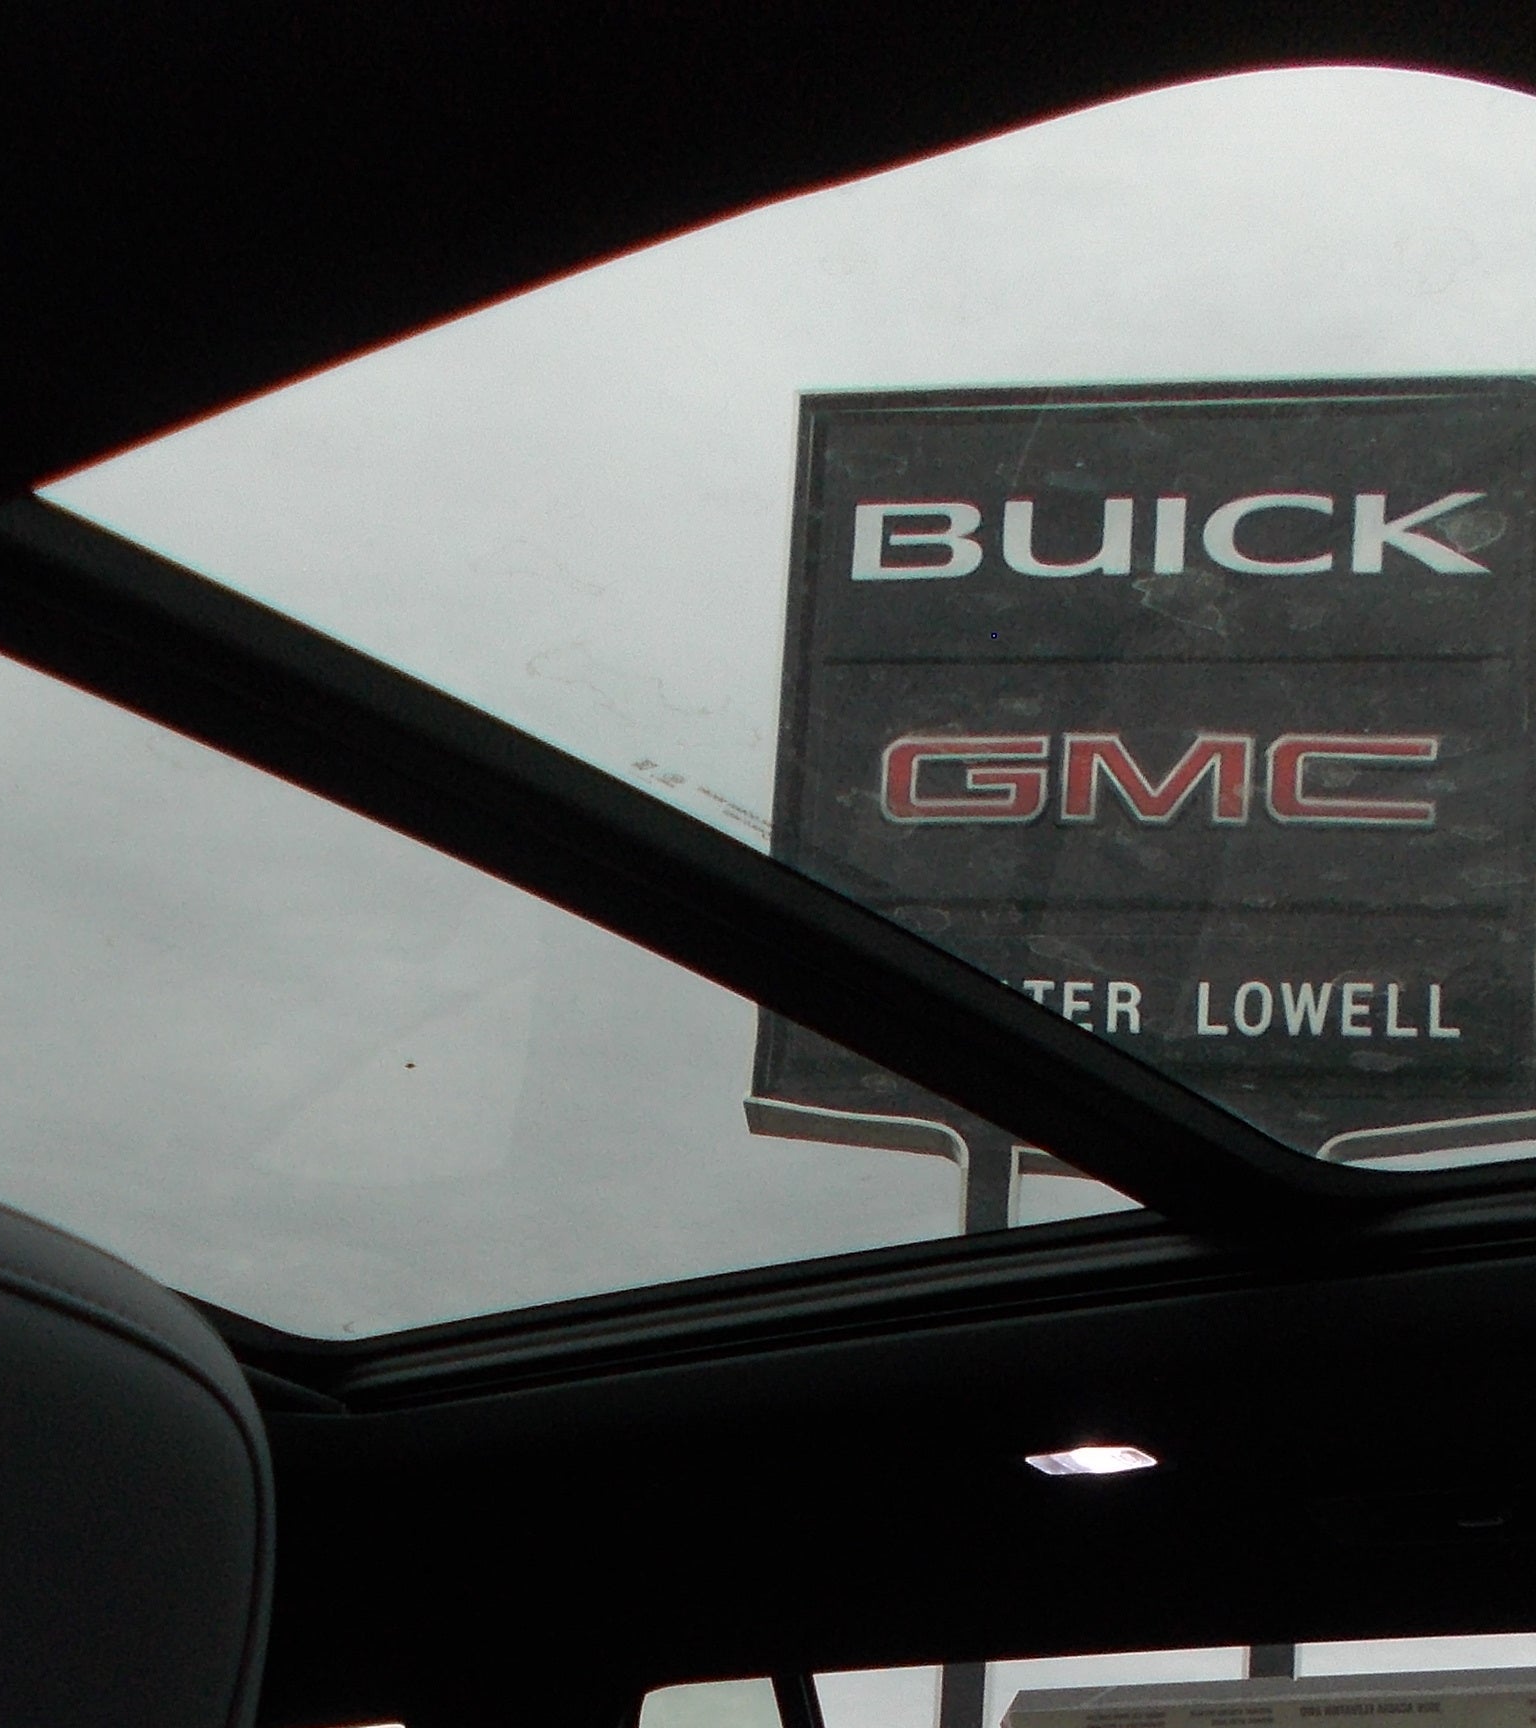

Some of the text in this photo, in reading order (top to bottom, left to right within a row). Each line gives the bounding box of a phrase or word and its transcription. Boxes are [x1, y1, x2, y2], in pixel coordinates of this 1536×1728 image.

[851, 491, 1492, 582] BUICK
[880, 732, 1440, 825] GMC
[1001, 978, 1462, 1038] TER LOWELL
